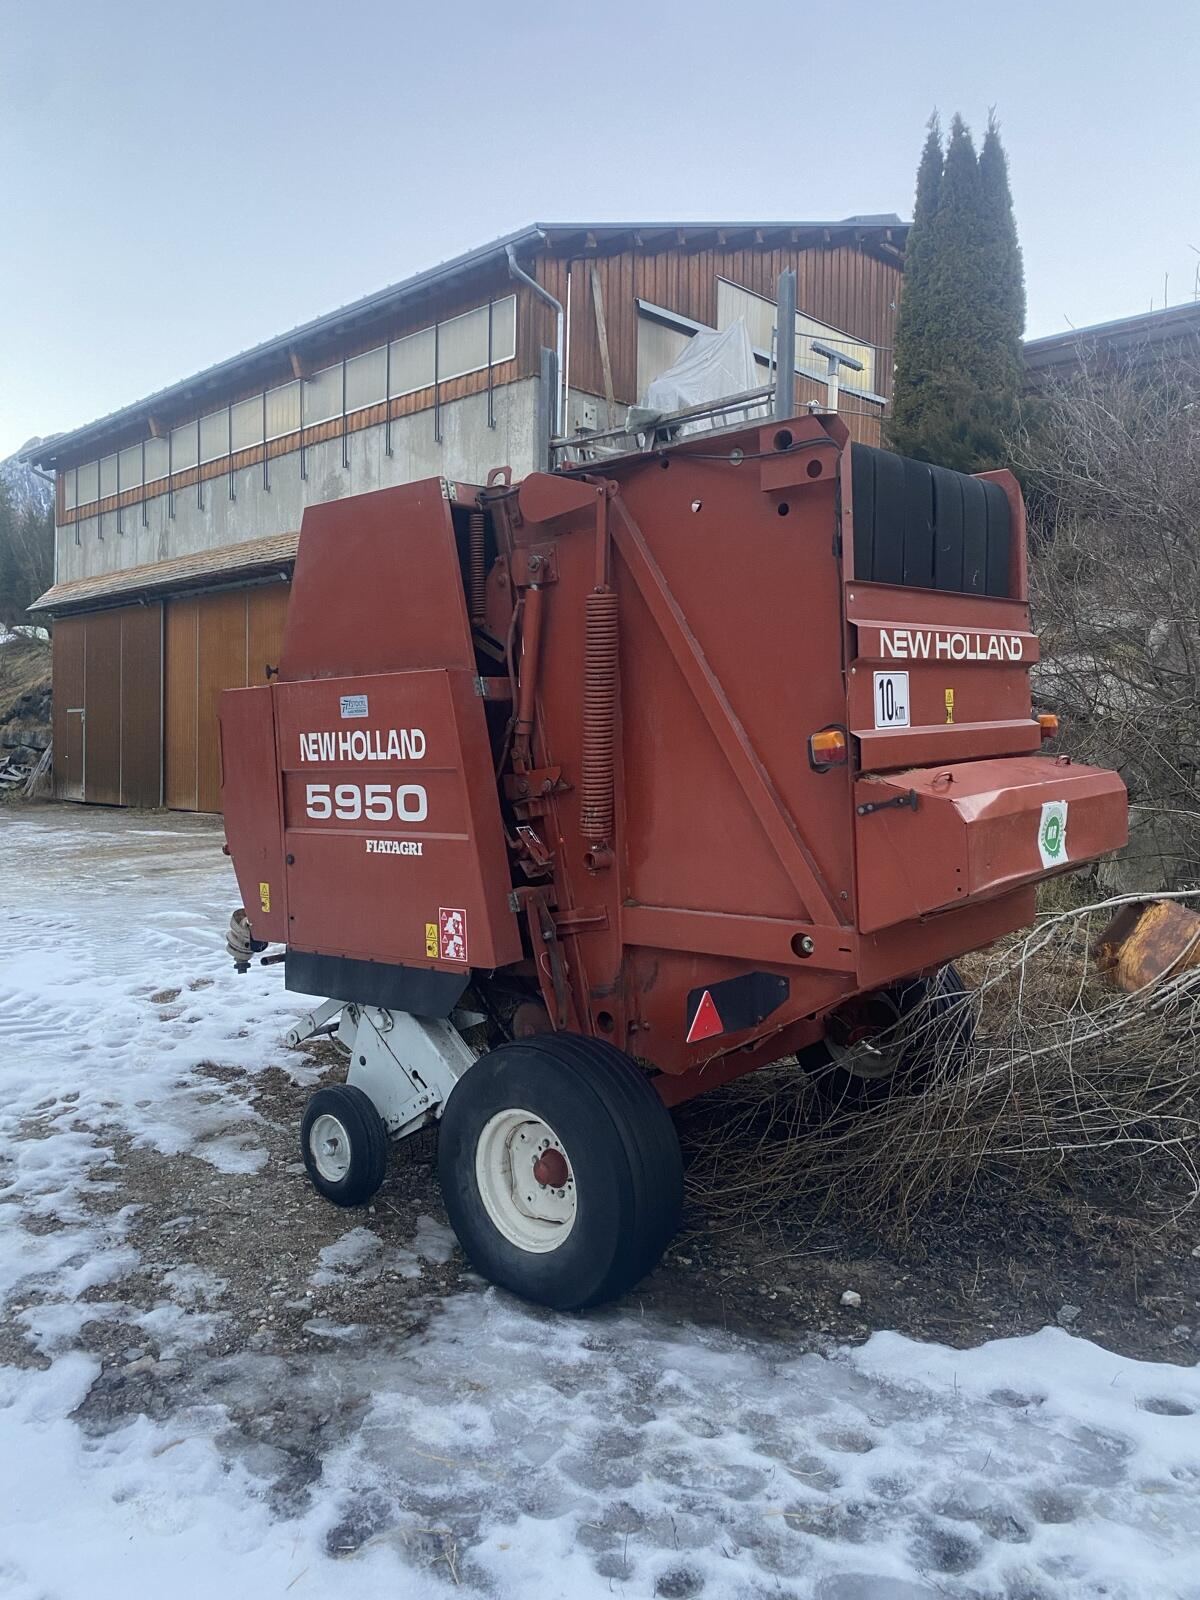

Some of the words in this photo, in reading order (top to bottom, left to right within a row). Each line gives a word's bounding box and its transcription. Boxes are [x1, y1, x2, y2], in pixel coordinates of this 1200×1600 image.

[880, 629, 931, 659] NEW
[935, 632, 1023, 661] HOLLAND
[878, 678, 894, 721] 10
[894, 701, 906, 720] km
[299, 732, 336, 762] NEW
[338, 728, 426, 761] HOLLAND
[306, 784, 428, 822] 5950
[365, 839, 423, 856] FIATAGRI
